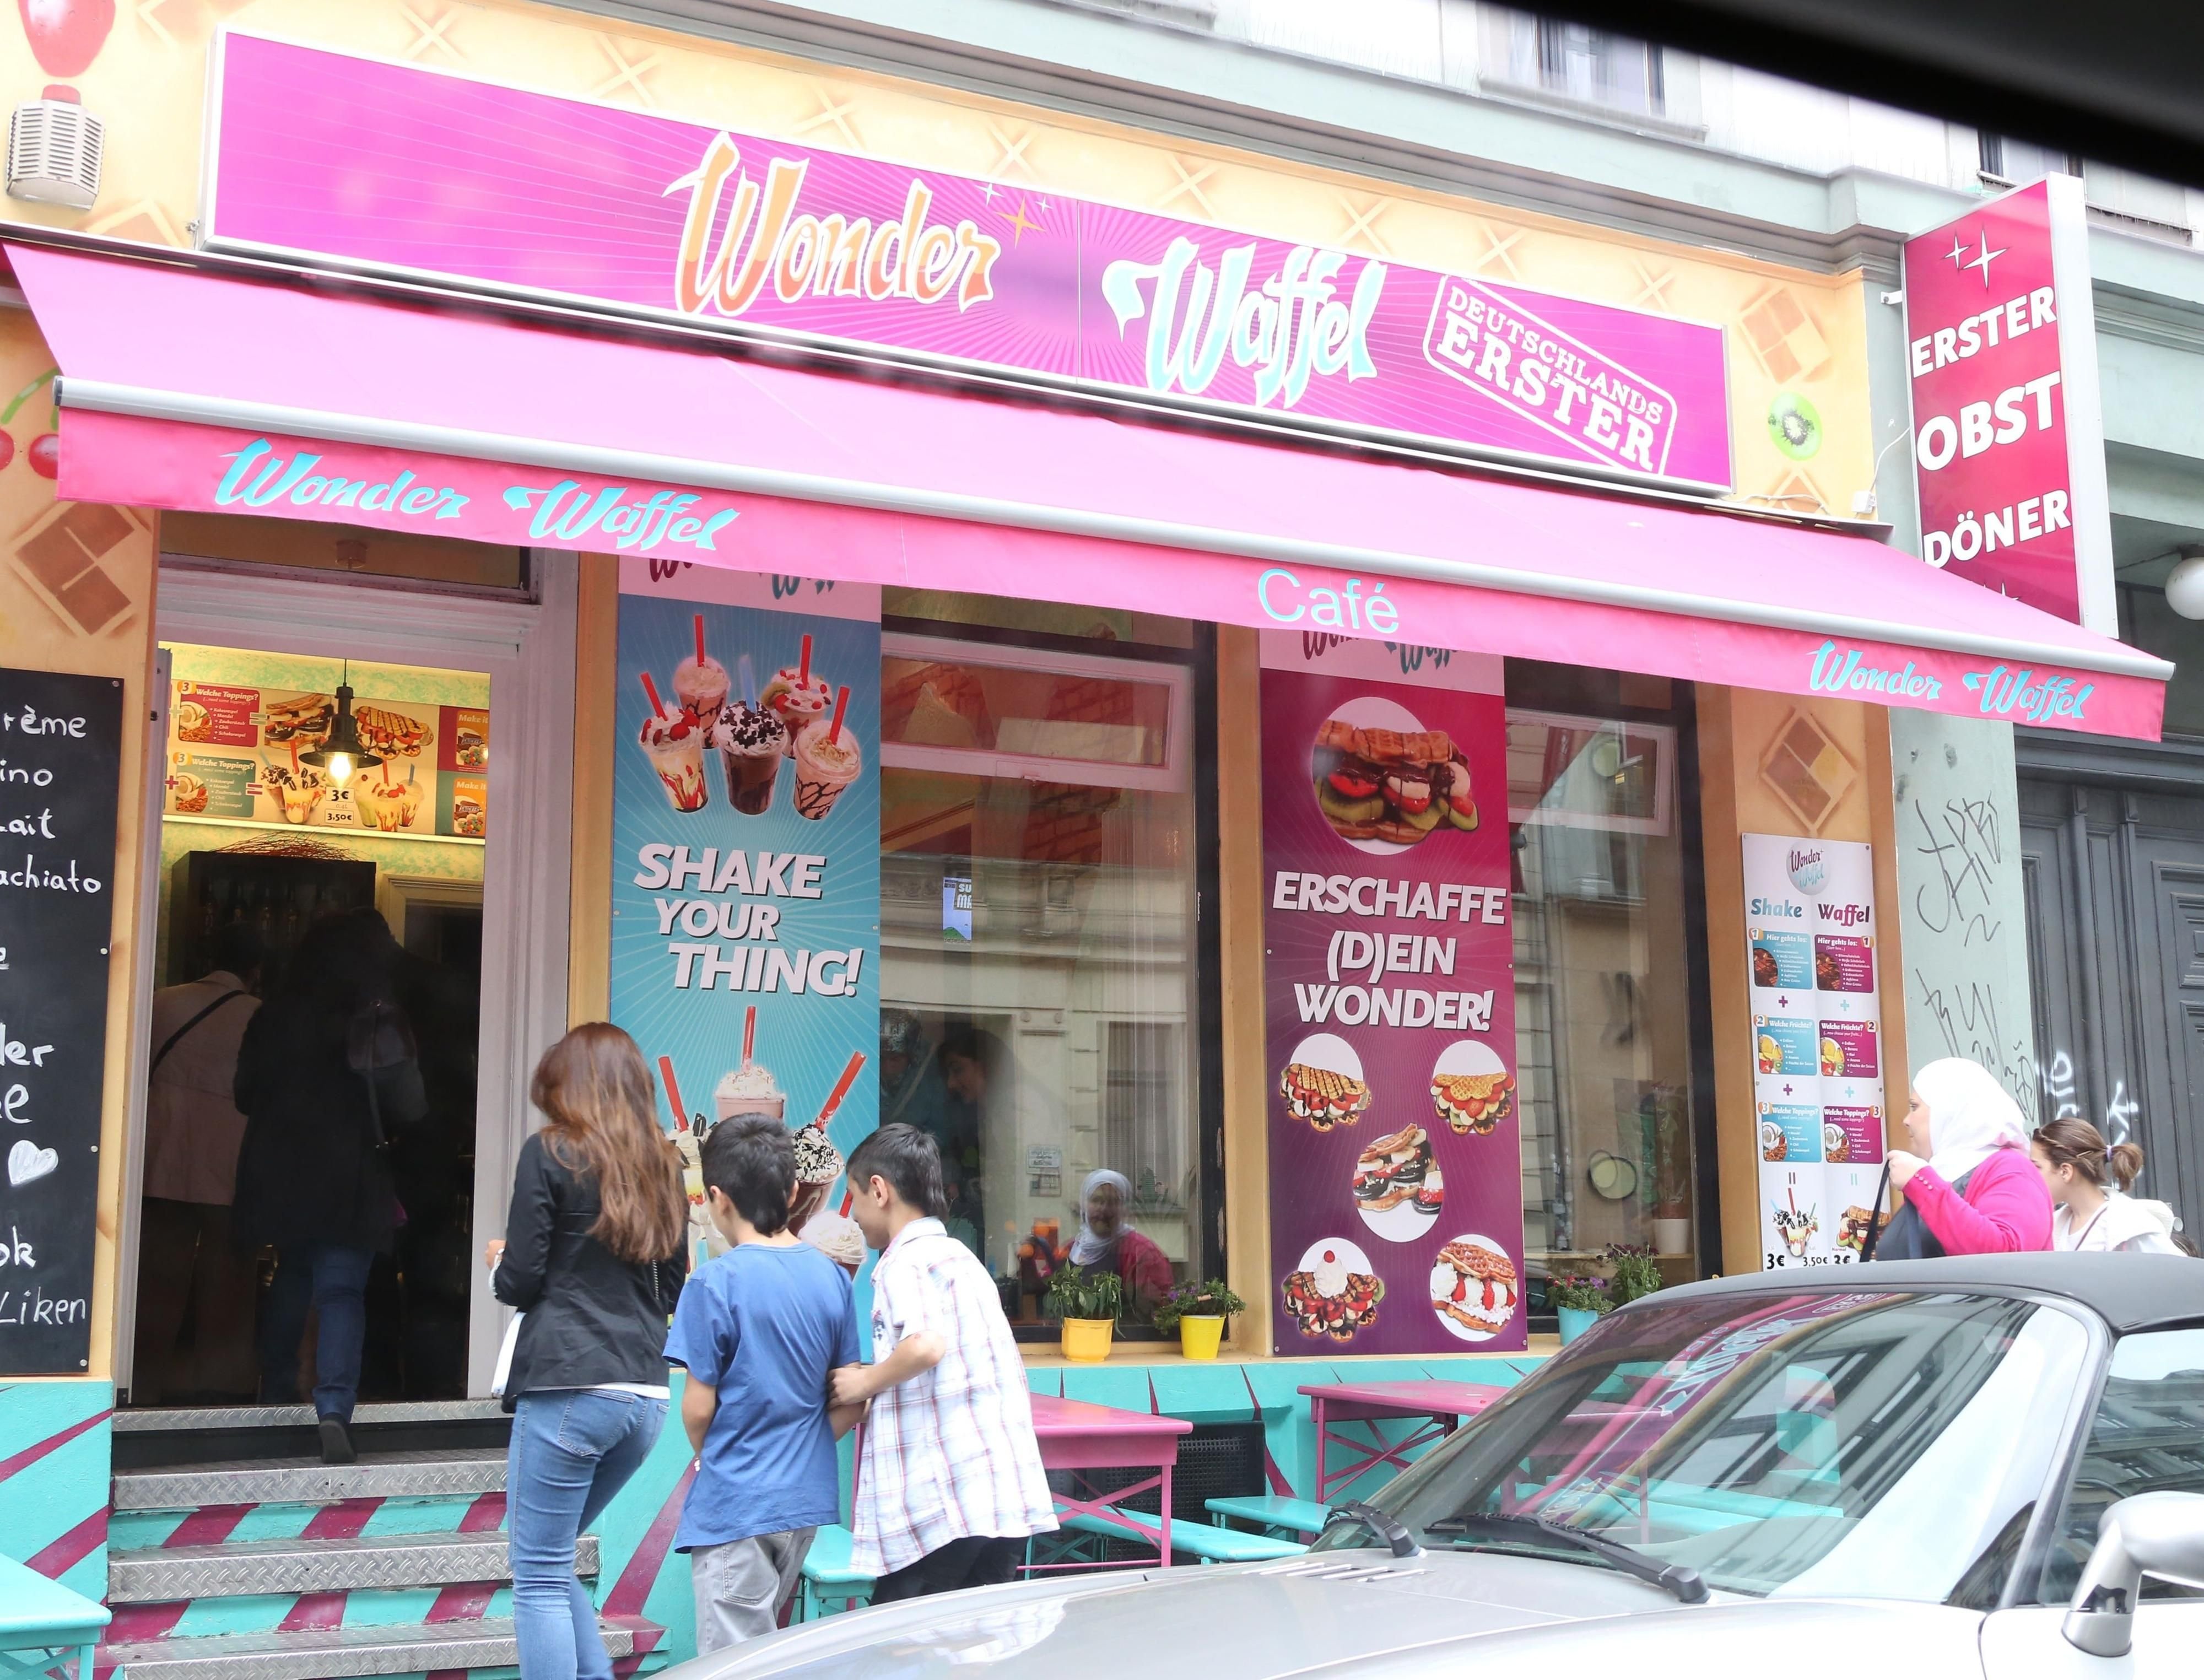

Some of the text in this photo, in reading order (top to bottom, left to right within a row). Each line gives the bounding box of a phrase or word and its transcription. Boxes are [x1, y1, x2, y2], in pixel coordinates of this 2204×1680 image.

[662, 131, 1387, 409] Wonder Waffel
[1911, 285, 2057, 379] ERSTER
[1447, 287, 1663, 424] DEUTSCHLANDS
[1436, 310, 1654, 472] ERSTER
[1916, 370, 2061, 472] OBST
[215, 438, 740, 552] Wonder Waffel
[1923, 489, 2072, 569] DÖNER
[1258, 568, 1400, 634] Café
[182, 682, 190, 692] 3
[196, 688, 259, 701] Welche Toppings?
[1806, 640, 2095, 723] Wonder Waffel
[458, 714, 481, 722] Make
[179, 753, 185, 763] 3
[192, 758, 255, 771] Welche Toppings?
[456, 781, 479, 790] Make
[327, 813, 352, 821] 3,50€
[634, 843, 827, 899] SHAKE
[1790, 848, 1821, 873] Wonder
[1273, 871, 1508, 925] ERSCHAFFE
[1751, 898, 1870, 927] Shake Waffel
[654, 898, 781, 941] YOUR
[1863, 937, 1868, 946] 1
[668, 942, 864, 997] THING!
[1327, 930, 1457, 984] (D)EIN
[1294, 982, 1494, 1032] WONDER!
[1758, 1016, 1763, 1024] 2
[1868, 1022, 1875, 1030] 2
[1763, 1103, 1768, 1112] 3
[1843, 1109, 1870, 1118] Toppings?
[1875, 1106, 1879, 1115] 3
[1803, 1257, 1828, 1267] 3,50€
